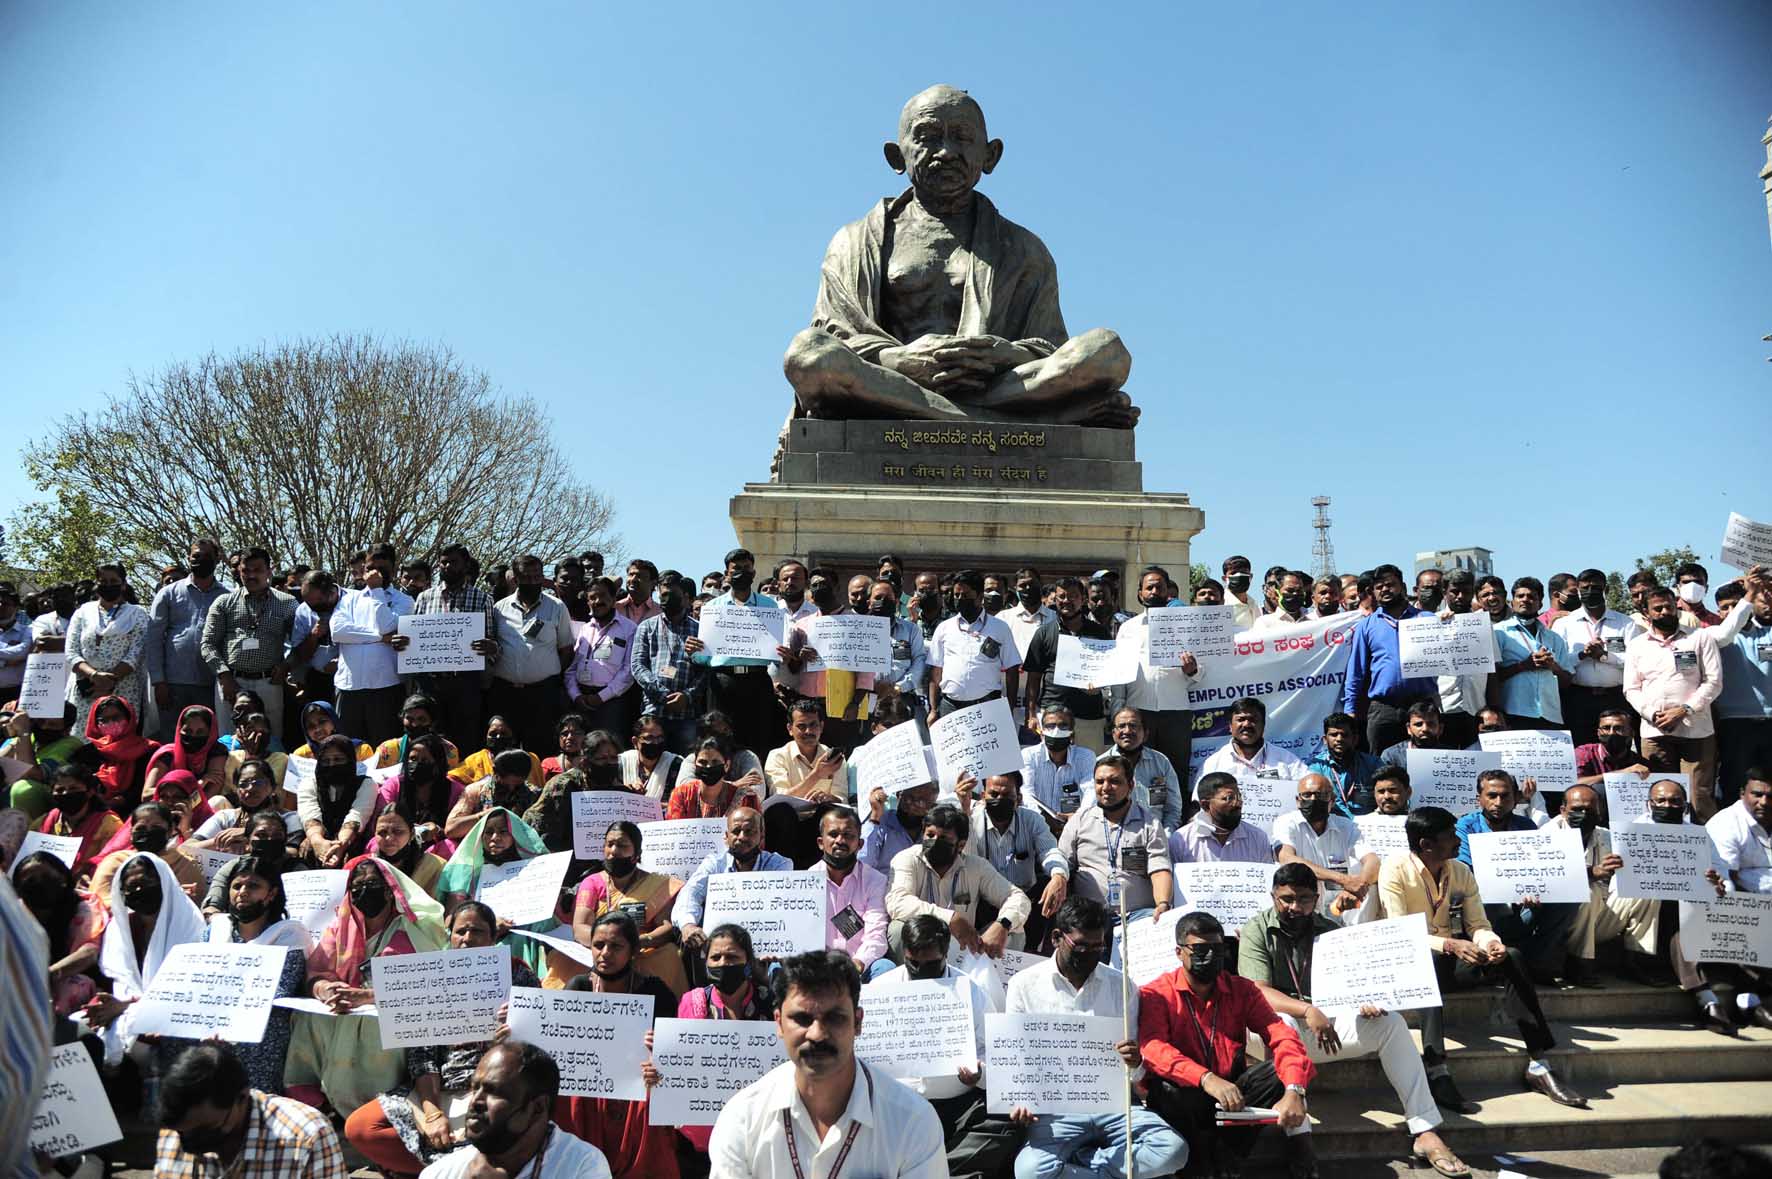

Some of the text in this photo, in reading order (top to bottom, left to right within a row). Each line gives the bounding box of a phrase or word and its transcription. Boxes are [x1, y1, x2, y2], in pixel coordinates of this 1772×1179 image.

[885, 428, 1046, 452] ನನ್ನ ಜೀವನವೇ ನನ್ನ ಸಂದೇಶ
[912, 463, 945, 478] जीवन
[1273, 631, 1315, 652] ಸಂಘ
[1187, 681, 1274, 704] EMPLOYEES
[971, 723, 997, 737] ವರದಿ
[1432, 769, 1477, 778] ಅನುಕಂಪದ
[1435, 781, 1473, 791] ನೇಮಕಾತಿ
[1499, 835, 1552, 851] ಅವೈಜ್ಞಾನಿಕ
[1537, 850, 1566, 861] ವರದಿ
[1633, 863, 1697, 876] ವೇತನ ಆಯೋಗ
[711, 896, 820, 918] ಸಚಿವಾಲಯ ನೌಕರರನ್ನು
[1706, 913, 1760, 927] ಸಚಿವಾಲಯದ
[383, 955, 499, 975] ಸಚಿವಾಲಯದಲ್ಲಿ ಅವಧಿ ಮೀರಿ
[513, 994, 546, 1020] ಮುಖ್ಯ
[540, 1021, 616, 1041] ಸಚಿವಾಲಯದ
[1023, 1022, 1087, 1034] ಆಡಳಿತ ಸುಧಾರಣೆ
[679, 1031, 778, 1049] ಸರ್ಕಾರದಲ್ಲಿ ಖಾಲಿ
[1029, 1038, 1078, 1049] ಸಚಿವಾಲಯದ
[658, 1052, 765, 1076] ಇರುವ ಹುದ್ದೆಗಳನ್ನು
